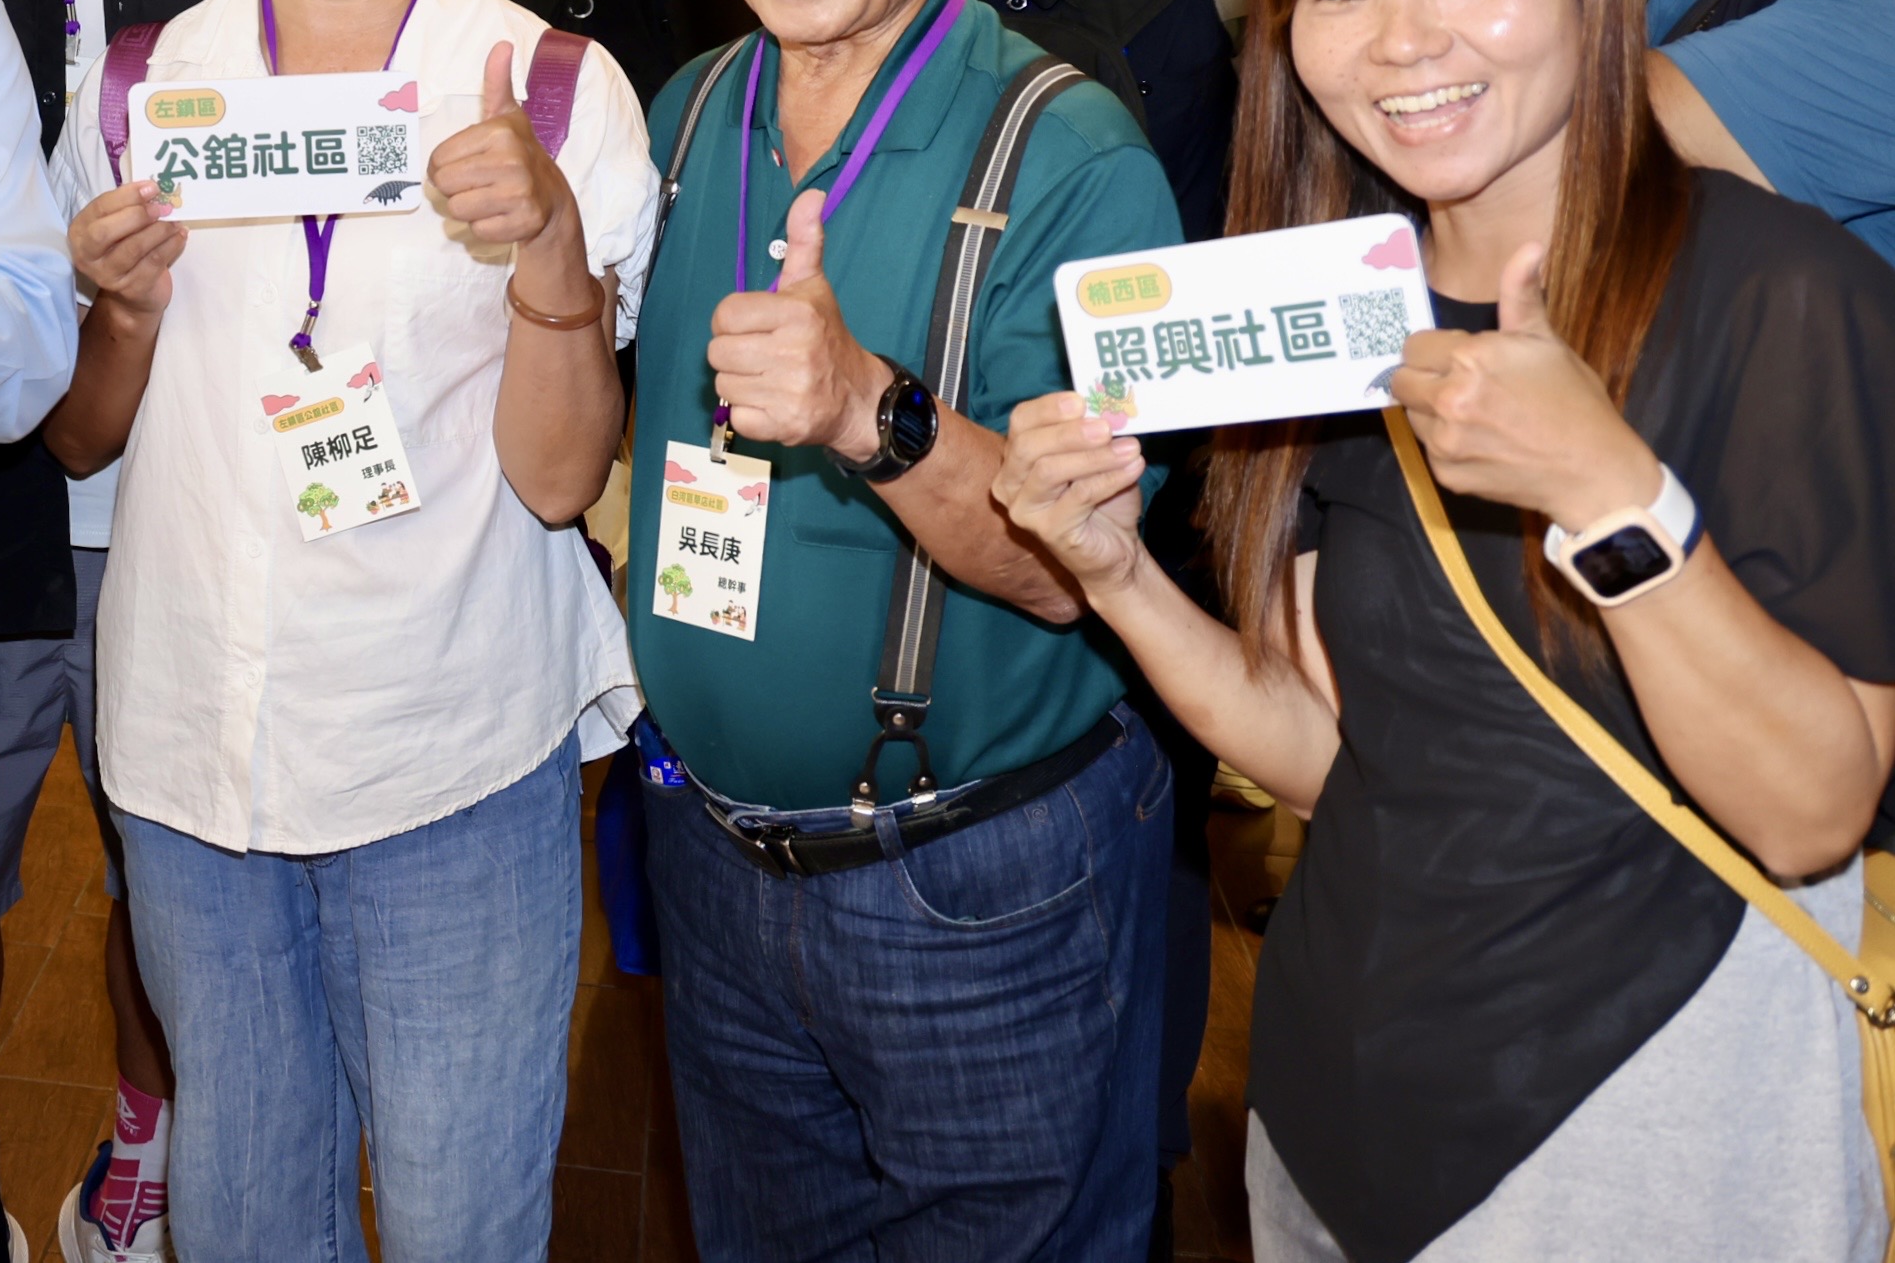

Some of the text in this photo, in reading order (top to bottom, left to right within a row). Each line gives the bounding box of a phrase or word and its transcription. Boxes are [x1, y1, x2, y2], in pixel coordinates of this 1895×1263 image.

[154, 97, 217, 119] 左鎮區
[1087, 273, 1161, 306] 楠西區
[1094, 300, 1337, 386] 照興社區
[301, 424, 379, 470] 陳柳足
[361, 458, 397, 481] 理事長
[678, 526, 742, 565] 吳長庚
[717, 576, 747, 594] 總幹事
